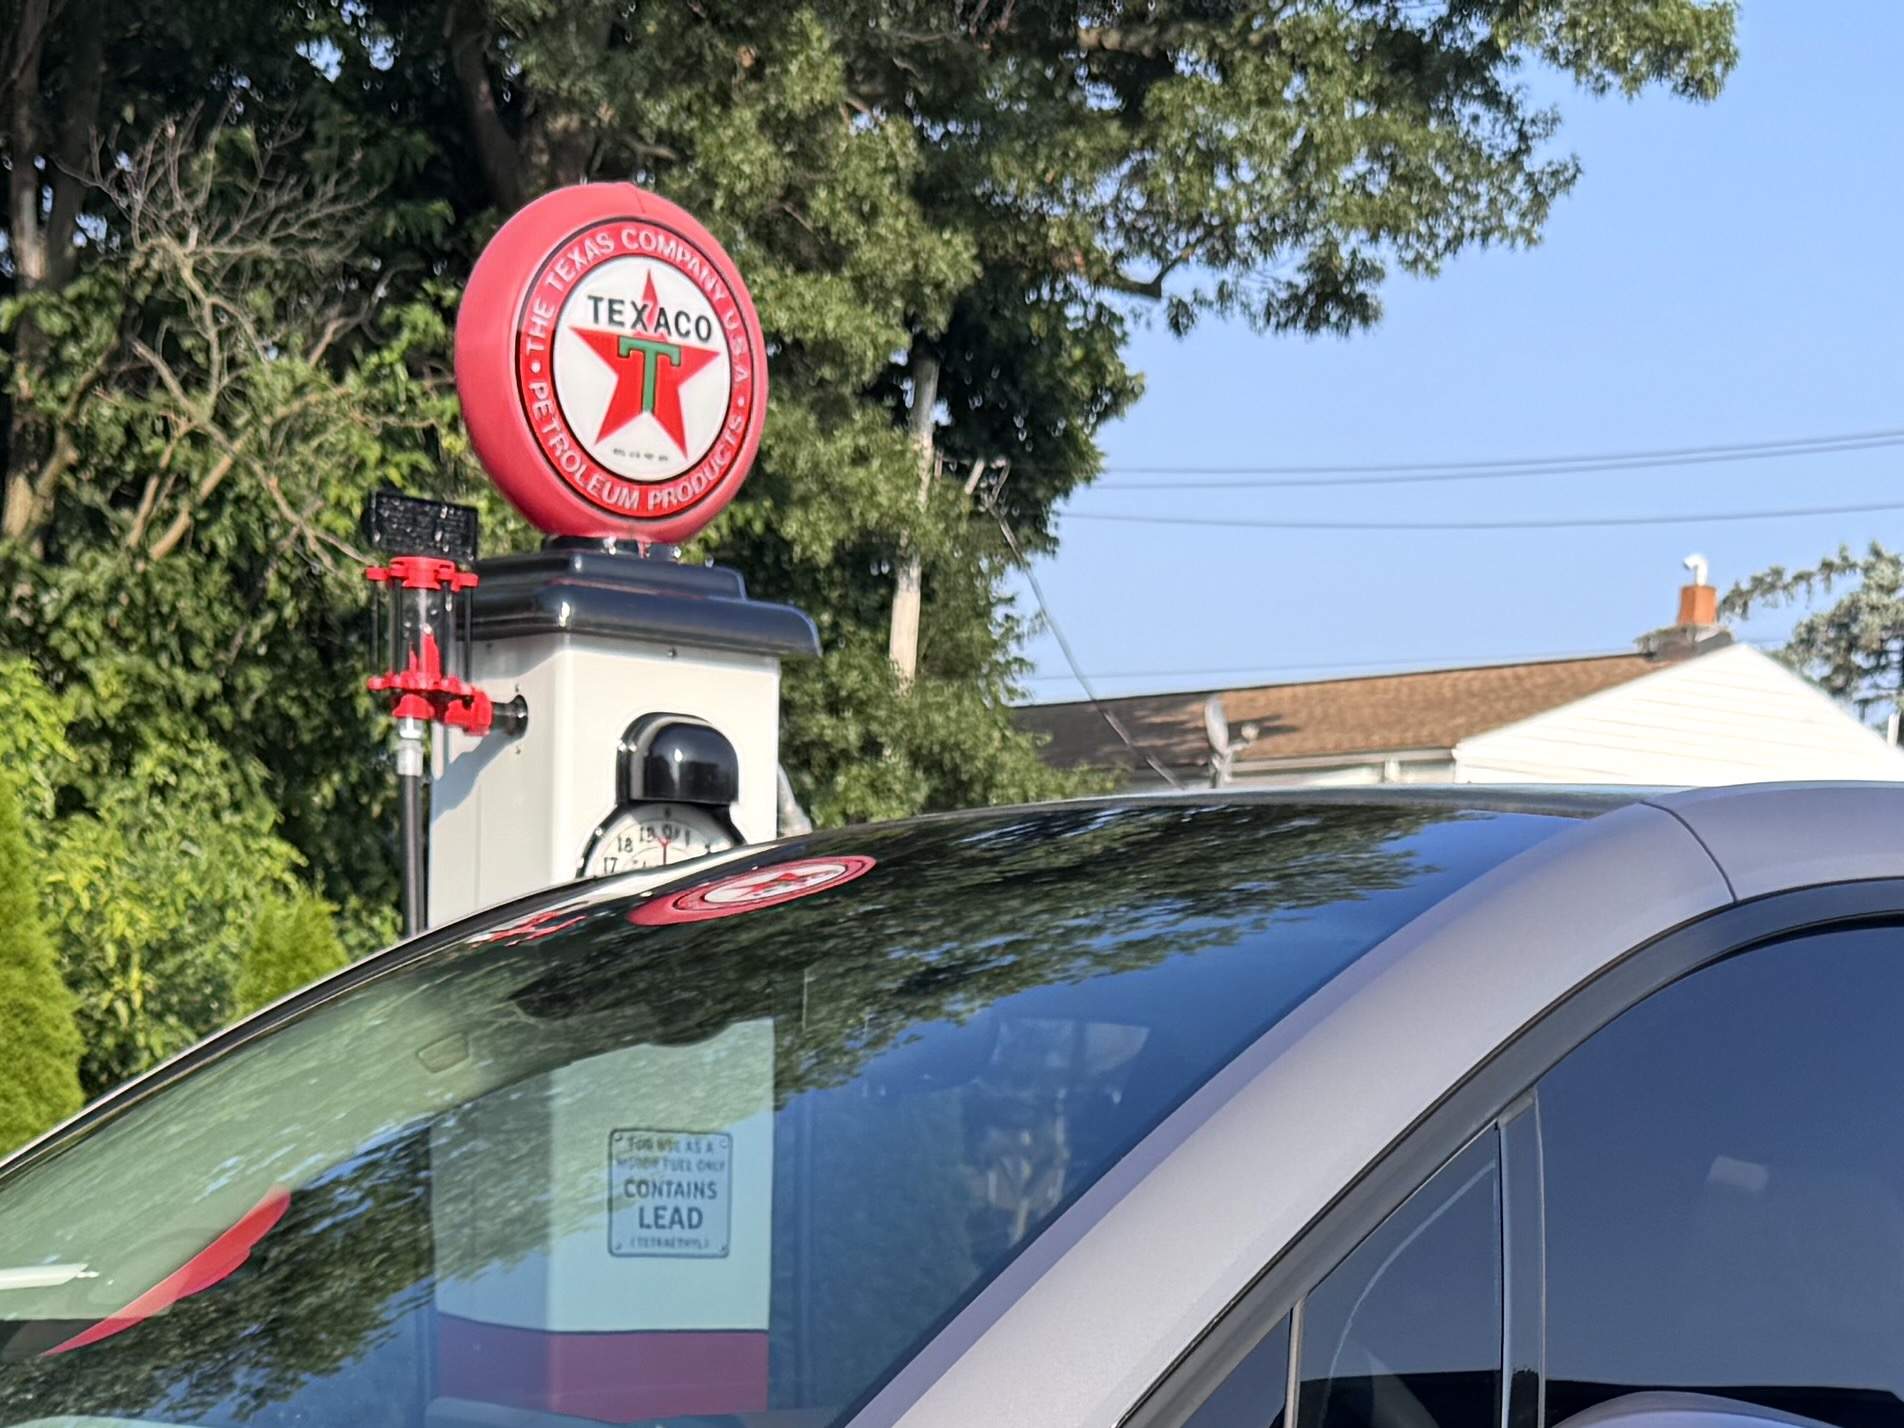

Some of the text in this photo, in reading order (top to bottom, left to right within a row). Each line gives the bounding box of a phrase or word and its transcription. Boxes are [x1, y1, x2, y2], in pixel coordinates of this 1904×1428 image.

[526, 302, 556, 356] THE
[544, 231, 616, 292] TEXAS
[621, 227, 727, 302] COMPANY
[586, 294, 711, 344] TEXACO
[618, 335, 682, 414] T
[528, 382, 744, 512] PETROLEUM PRODUCTS
[623, 1178, 719, 1200] CONTAINS
[638, 1205, 704, 1230] LEAD
